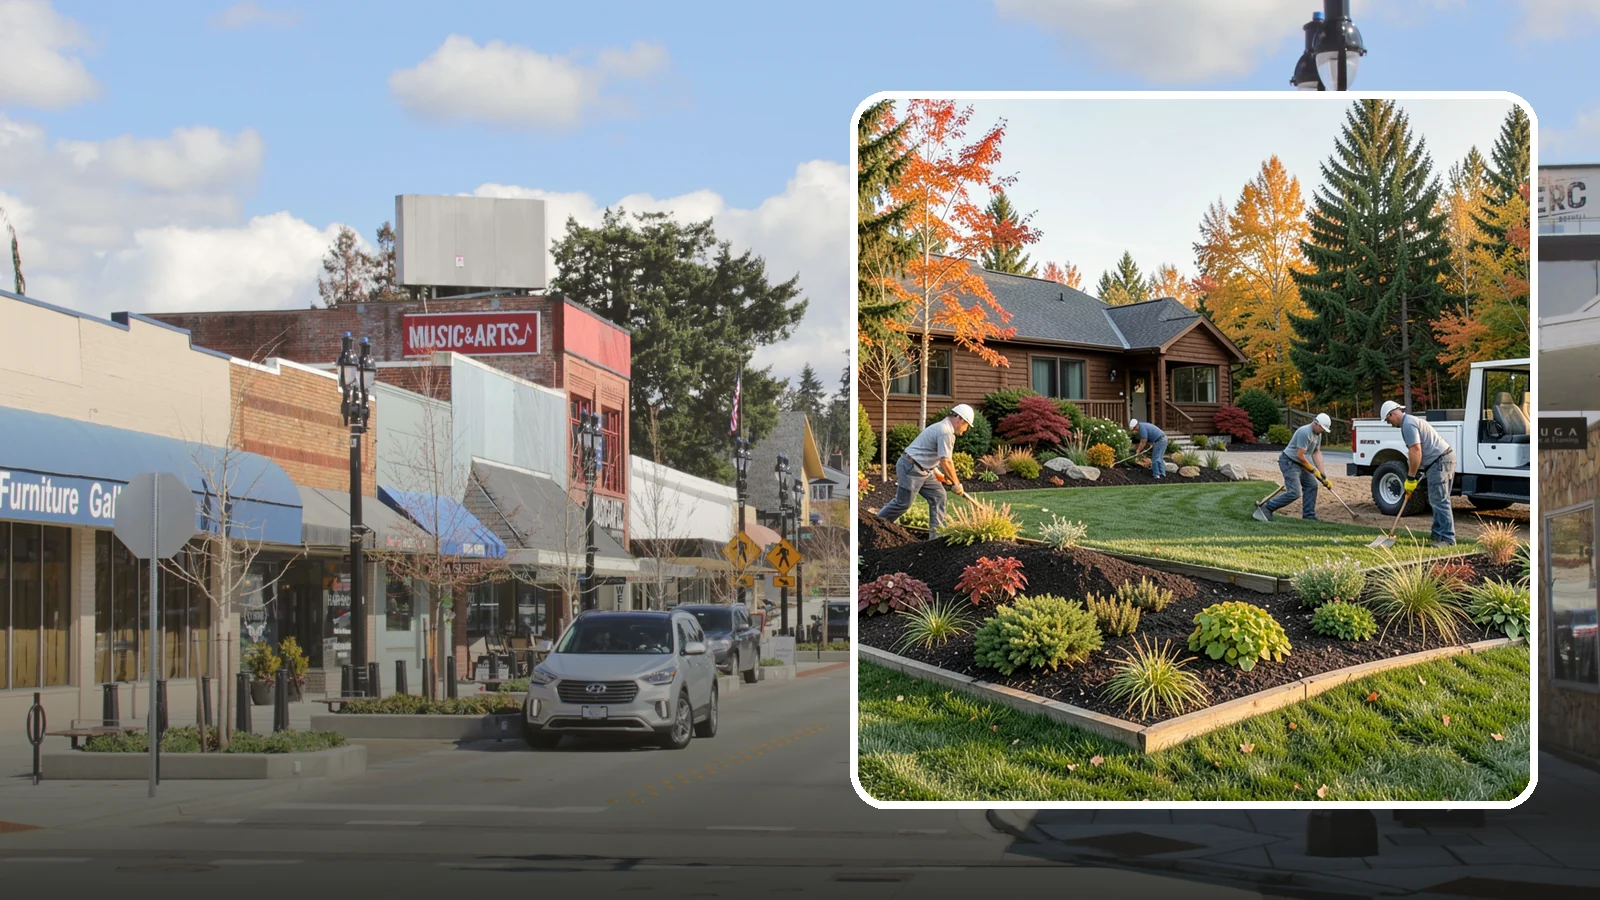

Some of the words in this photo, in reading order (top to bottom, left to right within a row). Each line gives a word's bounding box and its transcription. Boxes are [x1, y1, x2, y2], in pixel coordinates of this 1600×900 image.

[408, 322, 519, 349] MUSIC&ARTS
[1540, 427, 1577, 436] UGA
[1552, 436, 1579, 445] Framing
[0, 471, 79, 515] Furniture
[89, 482, 122, 519] Gal
[453, 563, 479, 574] SUSHI
